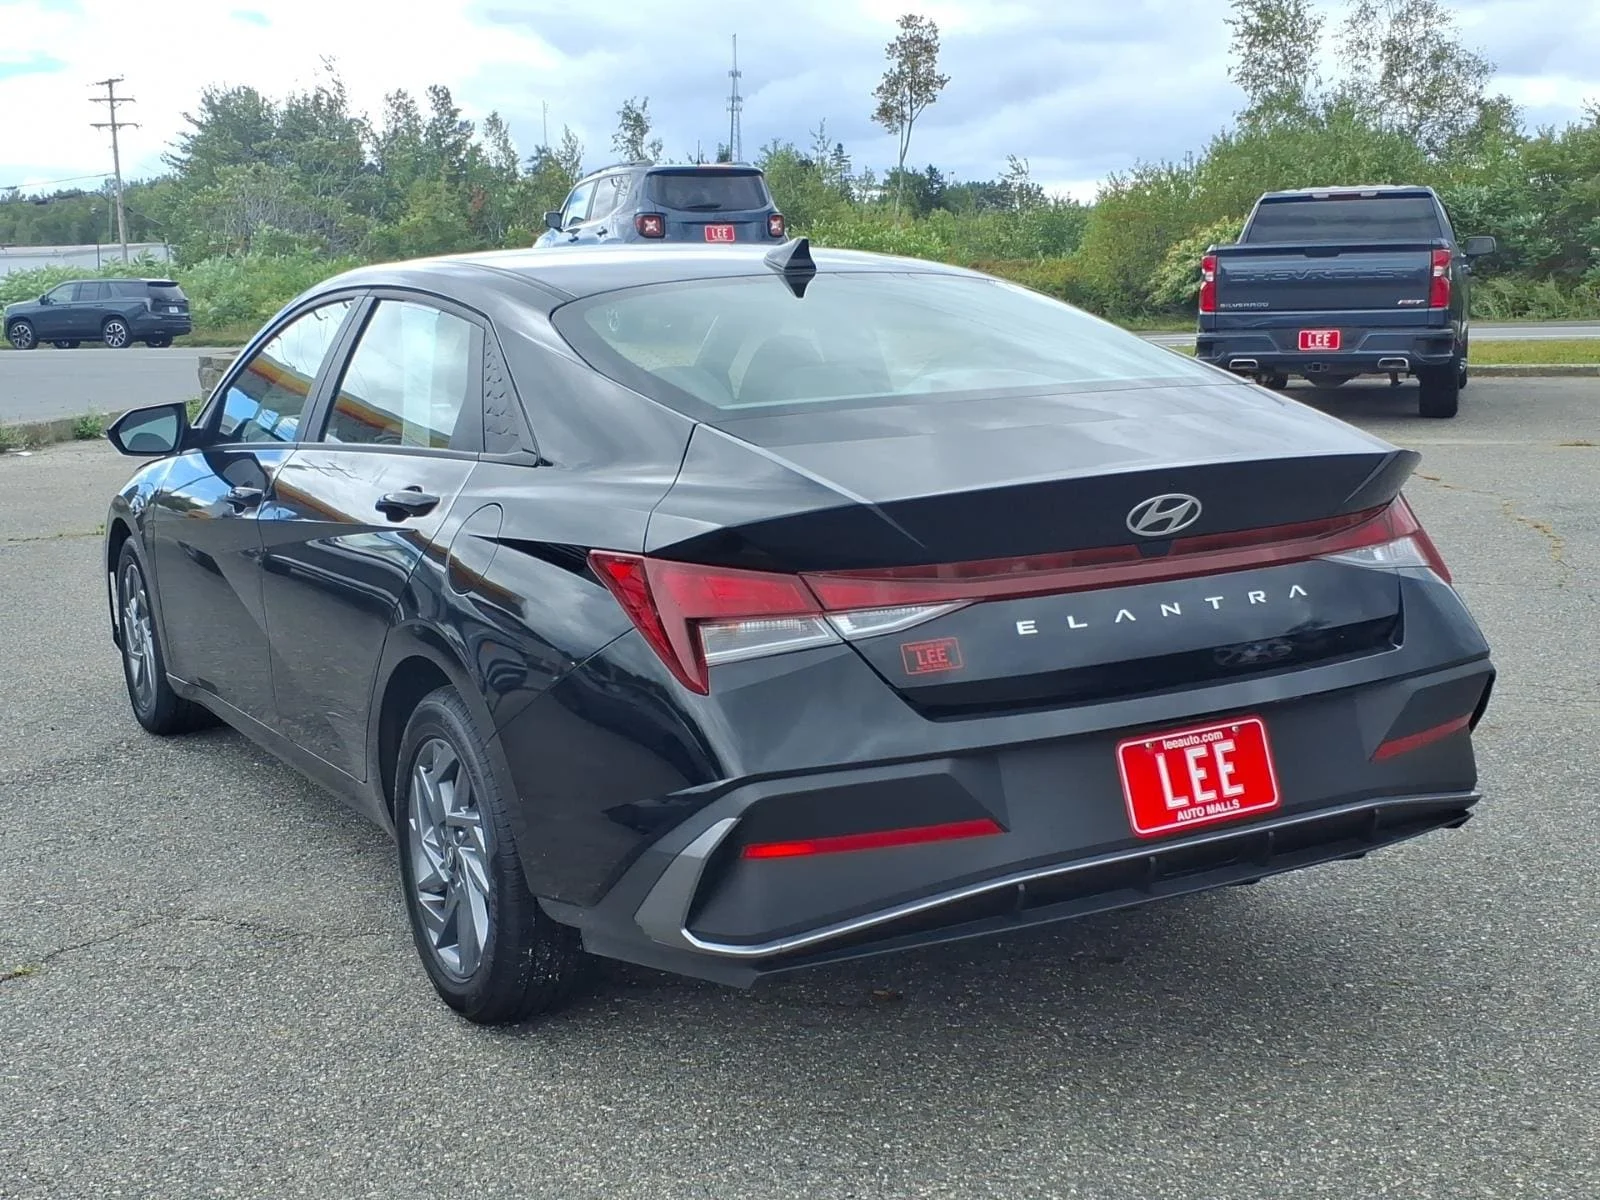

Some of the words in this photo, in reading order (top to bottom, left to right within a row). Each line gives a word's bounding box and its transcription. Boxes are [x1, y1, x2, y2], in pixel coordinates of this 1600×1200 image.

[1230, 266, 1416, 282] CHEVROLET
[1308, 333, 1331, 347] LEE
[1016, 585, 1308, 635] ELANTRA
[916, 647, 948, 666] LEE
[1162, 730, 1224, 751] leeauto.com
[1155, 738, 1245, 810] LEE
[1177, 807, 1206, 822] AUTO
[1206, 798, 1240, 815] MALLS
